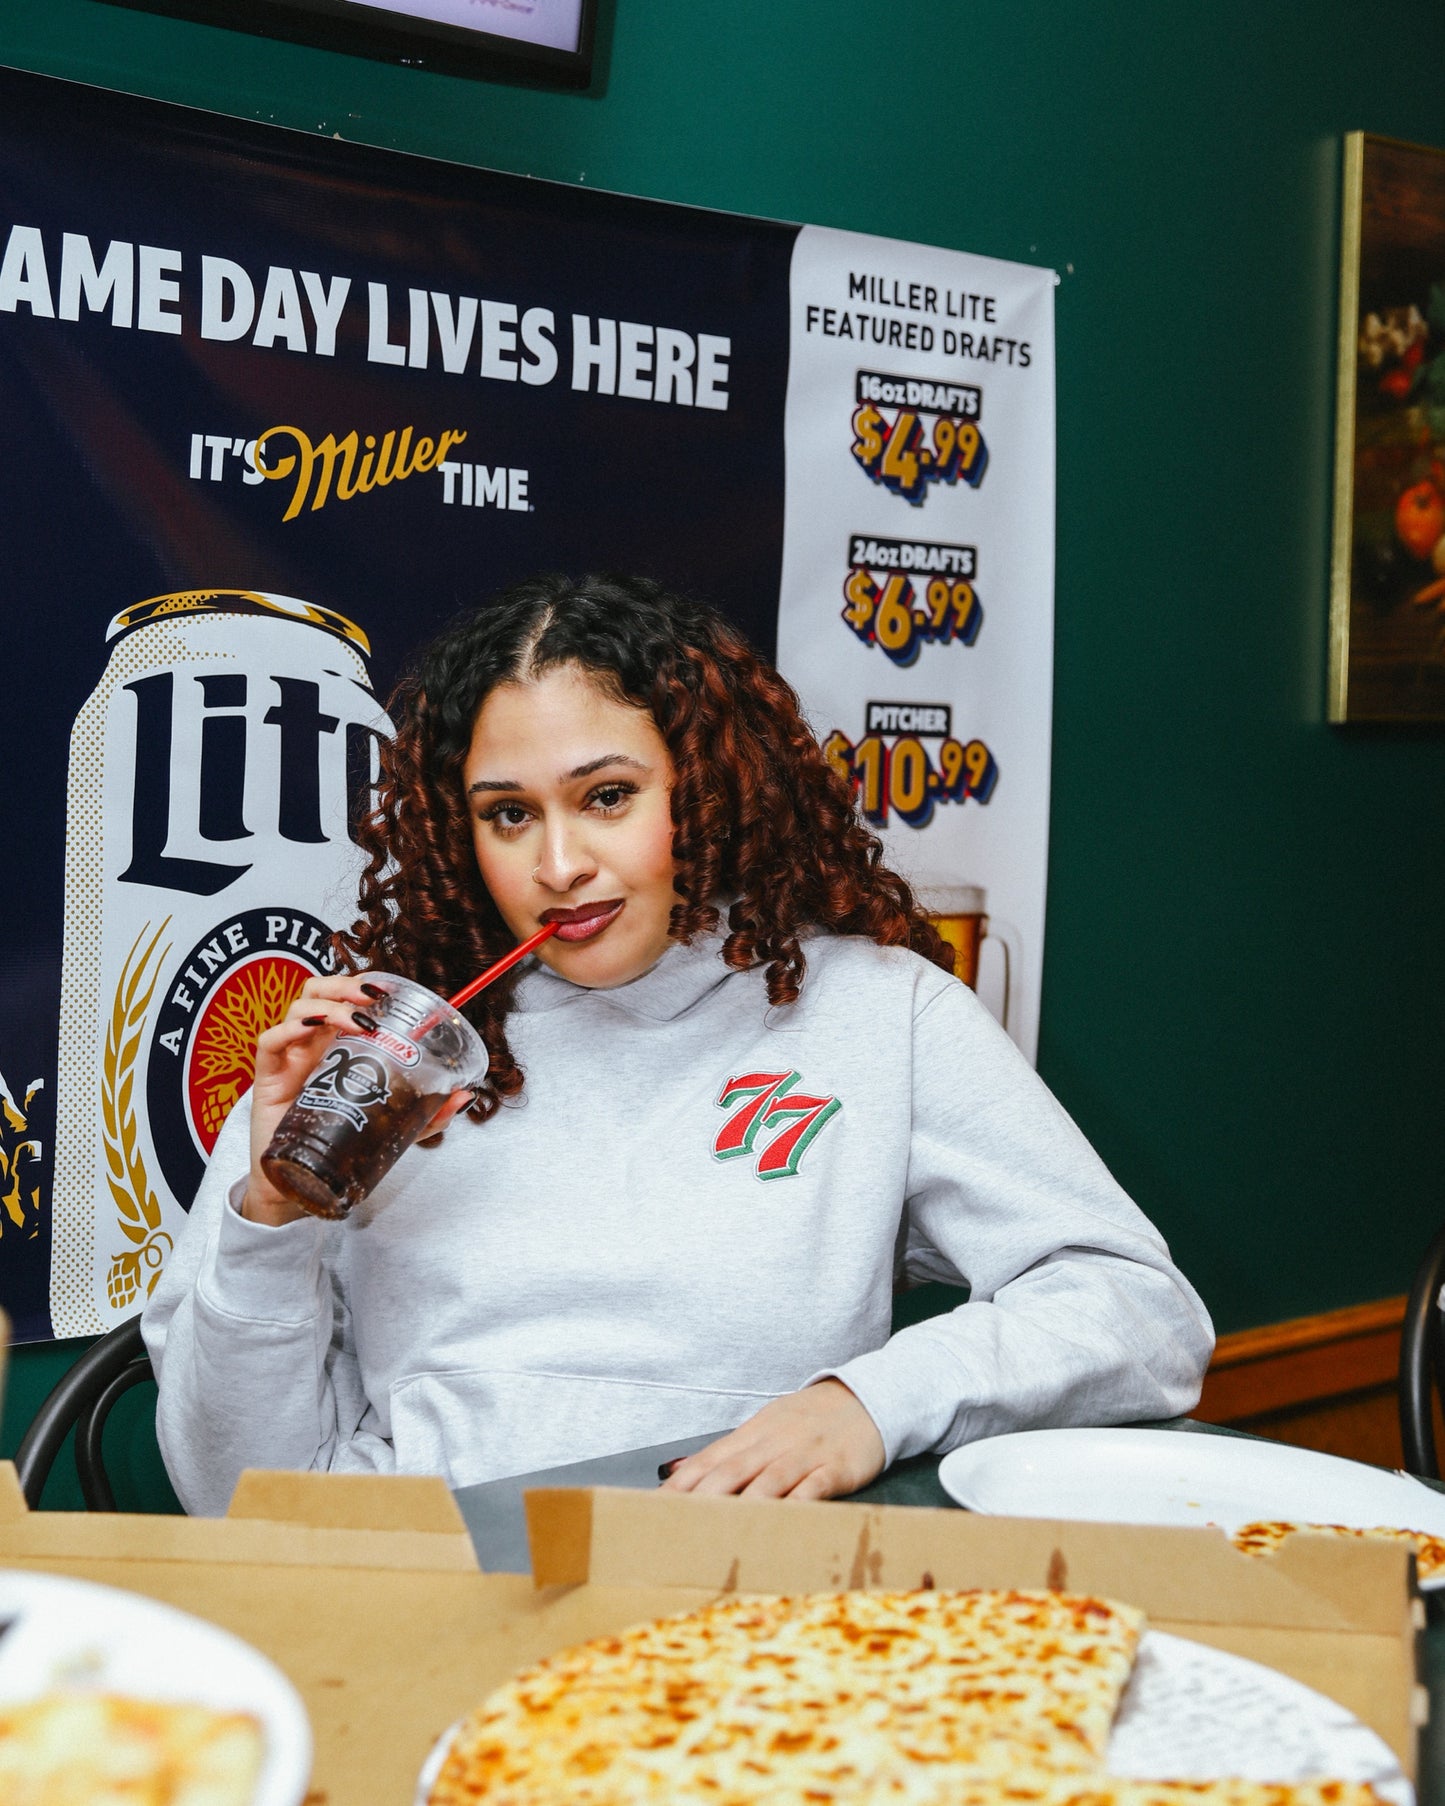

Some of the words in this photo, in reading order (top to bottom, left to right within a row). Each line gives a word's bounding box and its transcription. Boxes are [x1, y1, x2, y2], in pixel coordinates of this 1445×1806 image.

[849, 272, 938, 314] MILLER
[946, 290, 997, 323] LITE
[200, 254, 352, 356] DAY
[367, 281, 559, 387] LIVES
[571, 313, 732, 411] HERE
[806, 305, 935, 352] FEATURED
[943, 329, 1032, 368] DRAFTS
[860, 375, 906, 403] 16oz
[906, 382, 978, 415] DRAFTS
[189, 433, 267, 486] IT'S
[254, 425, 468, 523] Miller
[851, 402, 984, 497] $4.99
[853, 538, 899, 567] 24oz
[899, 543, 973, 575] DRAFTS
[842, 567, 979, 658] $6.99
[869, 705, 949, 733] PITCHER
[171, 922, 250, 1014] FINE
[159, 1027, 184, 1057] A
[307, 1048, 388, 1107] 20
[712, 1068, 843, 1182] 77
